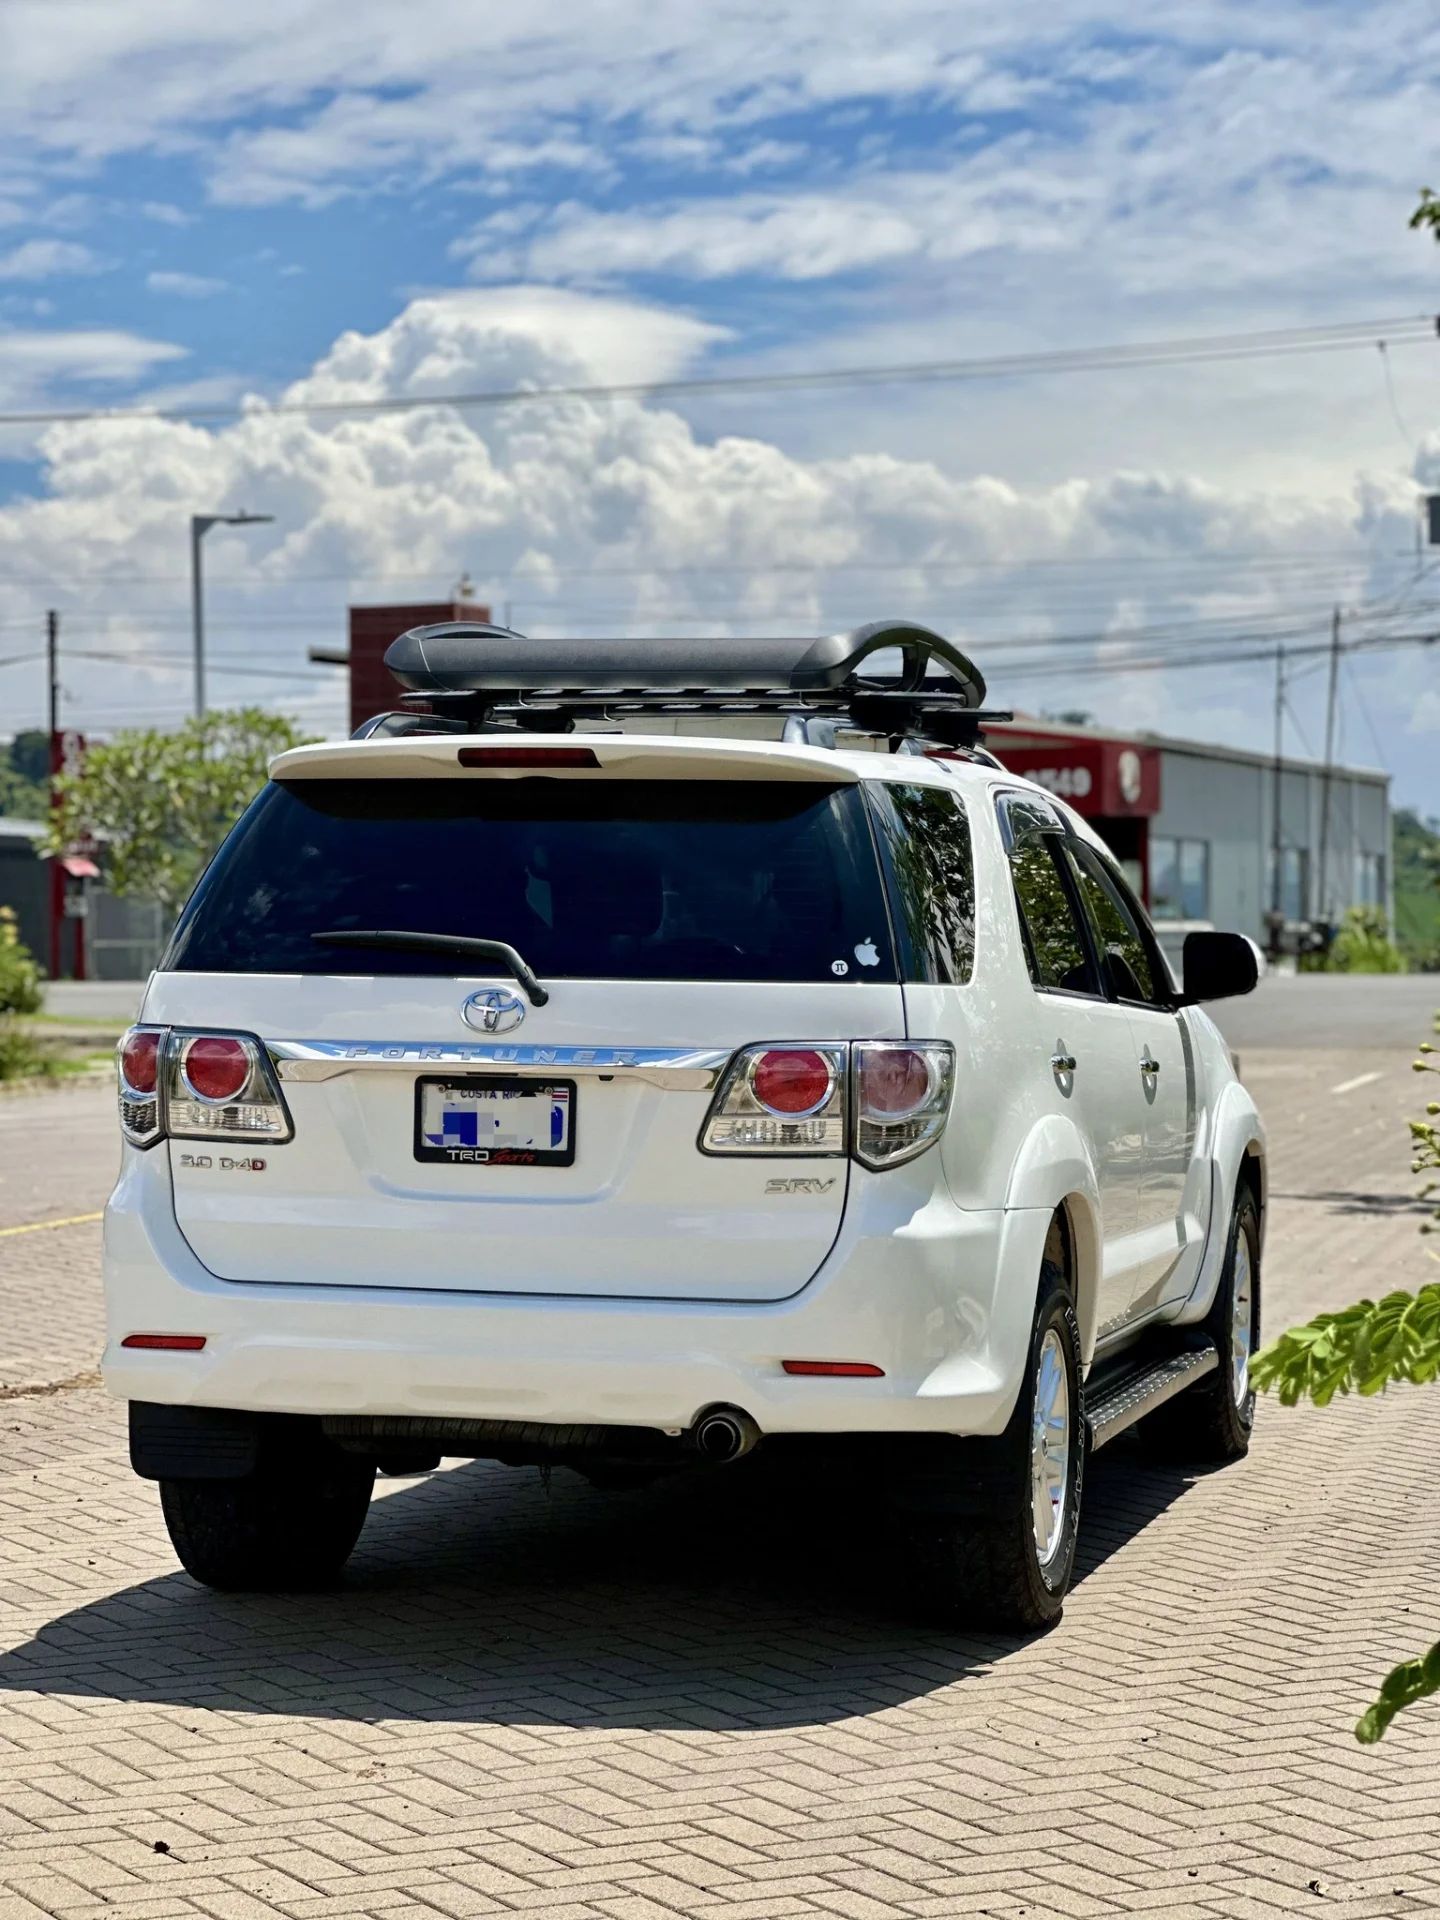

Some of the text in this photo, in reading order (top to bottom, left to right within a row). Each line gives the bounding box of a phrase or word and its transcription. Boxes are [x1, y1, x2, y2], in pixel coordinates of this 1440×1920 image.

[345, 1046, 640, 1065] FORTUNER
[460, 1090, 522, 1100] COSTA RIC
[181, 1154, 267, 1171] 3.0 D-4D
[446, 1149, 536, 1166] TRD Sports
[764, 1178, 836, 1194] SRV
